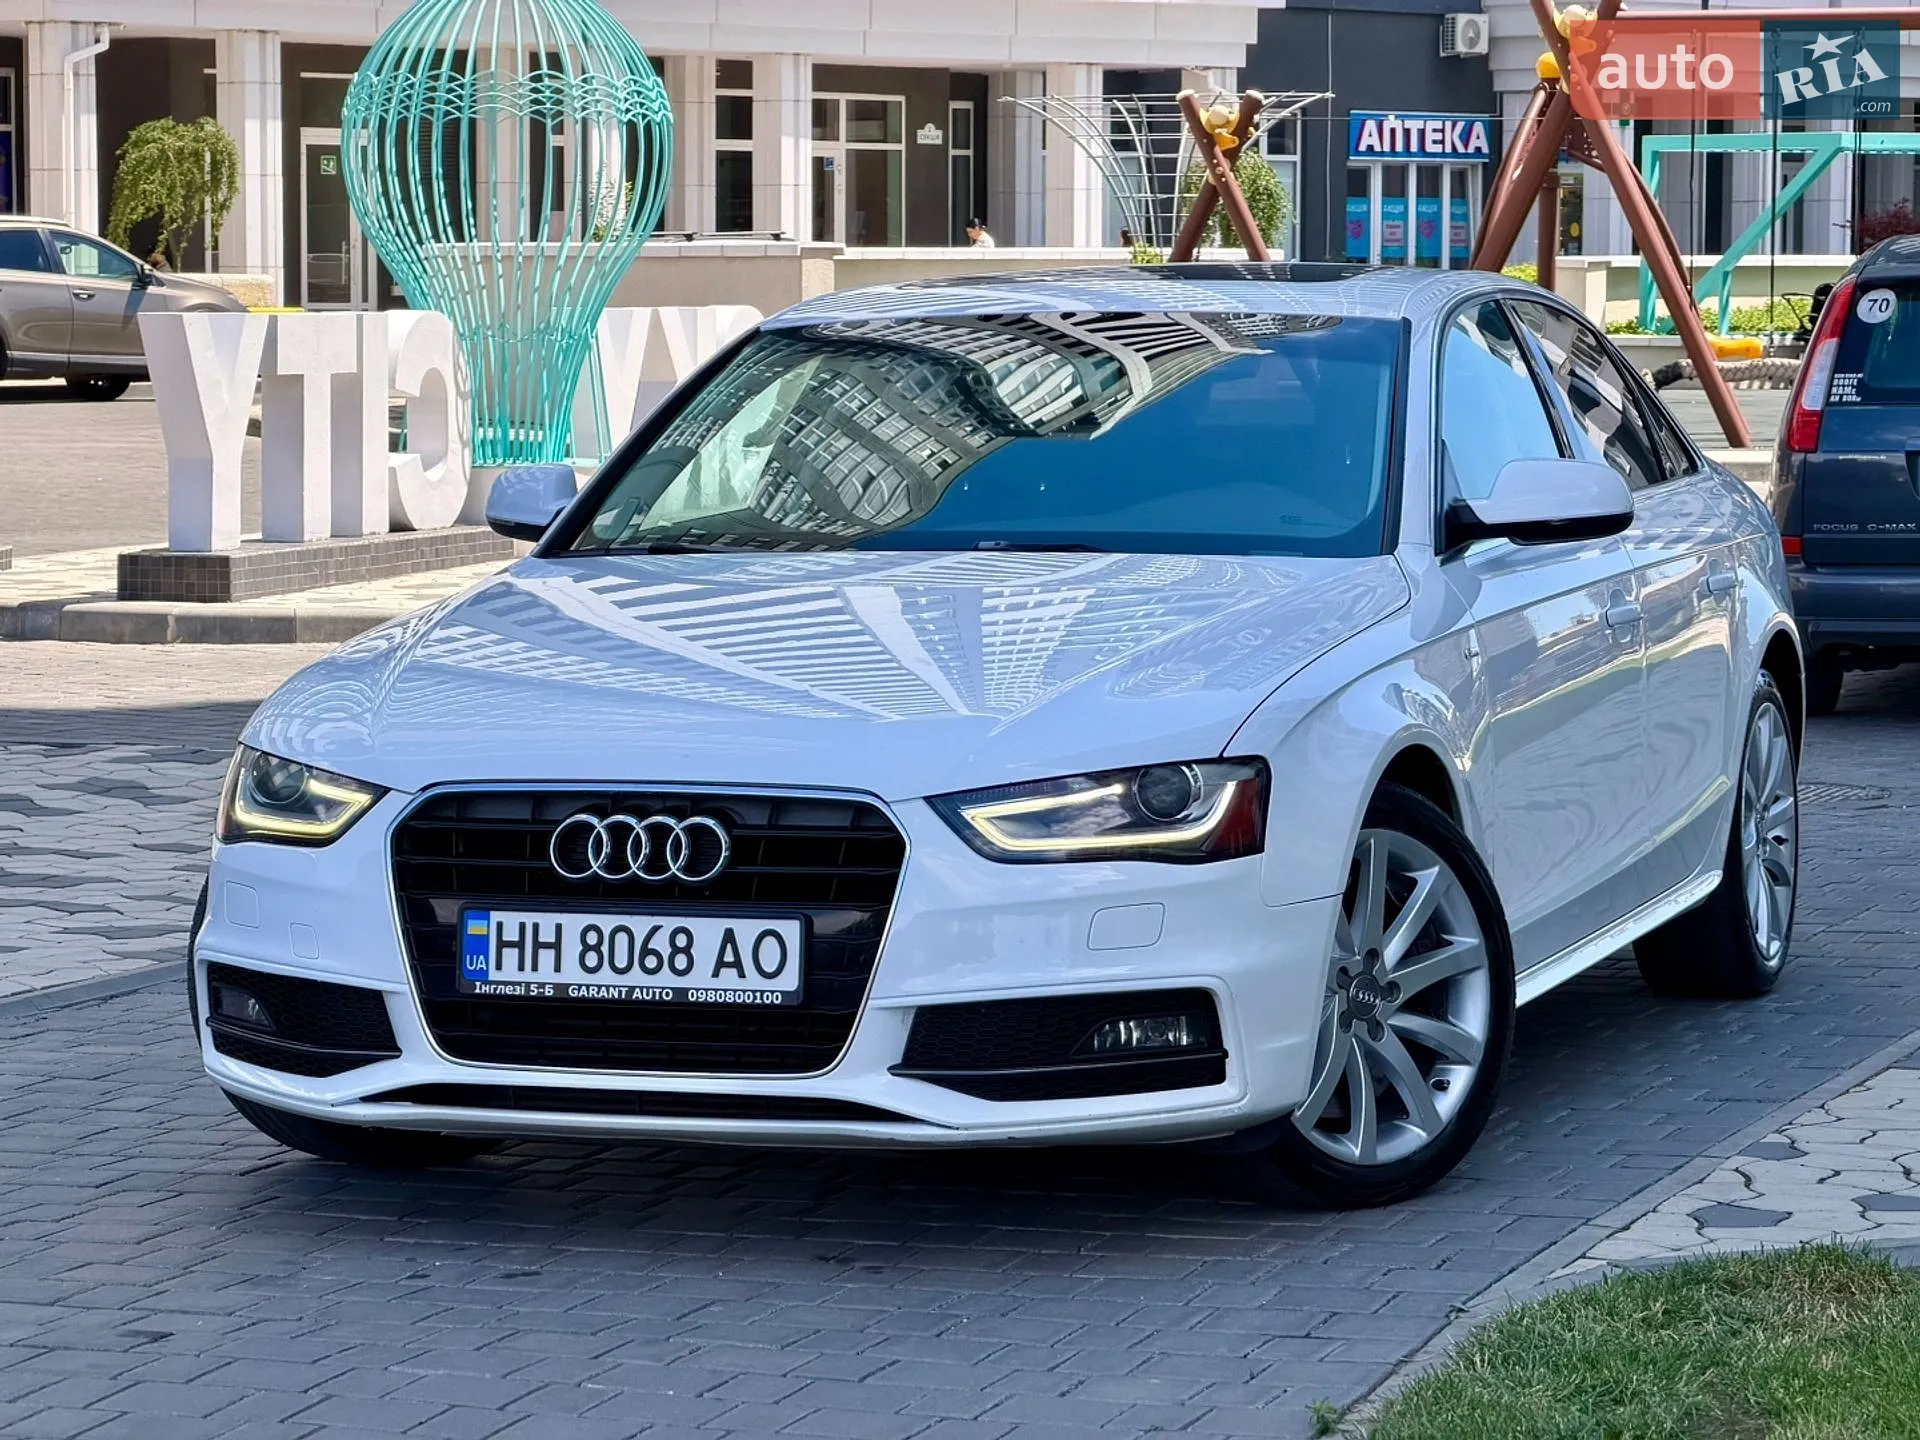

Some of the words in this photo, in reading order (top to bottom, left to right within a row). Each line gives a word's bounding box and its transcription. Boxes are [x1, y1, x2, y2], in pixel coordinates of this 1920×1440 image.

[1358, 119, 1490, 153] АПТЕКА
[1867, 298, 1890, 313] 70
[1813, 523, 1859, 531] FOCUS
[1867, 523, 1917, 531] C-MAX
[495, 920, 563, 973] HH
[578, 923, 695, 977] 8068
[711, 926, 789, 980] AO
[466, 954, 487, 971] UA
[474, 981, 525, 996] Інглезі
[568, 985, 629, 999] GARANT
[633, 987, 673, 1001] AUTO
[688, 989, 782, 1004] 0980800100
